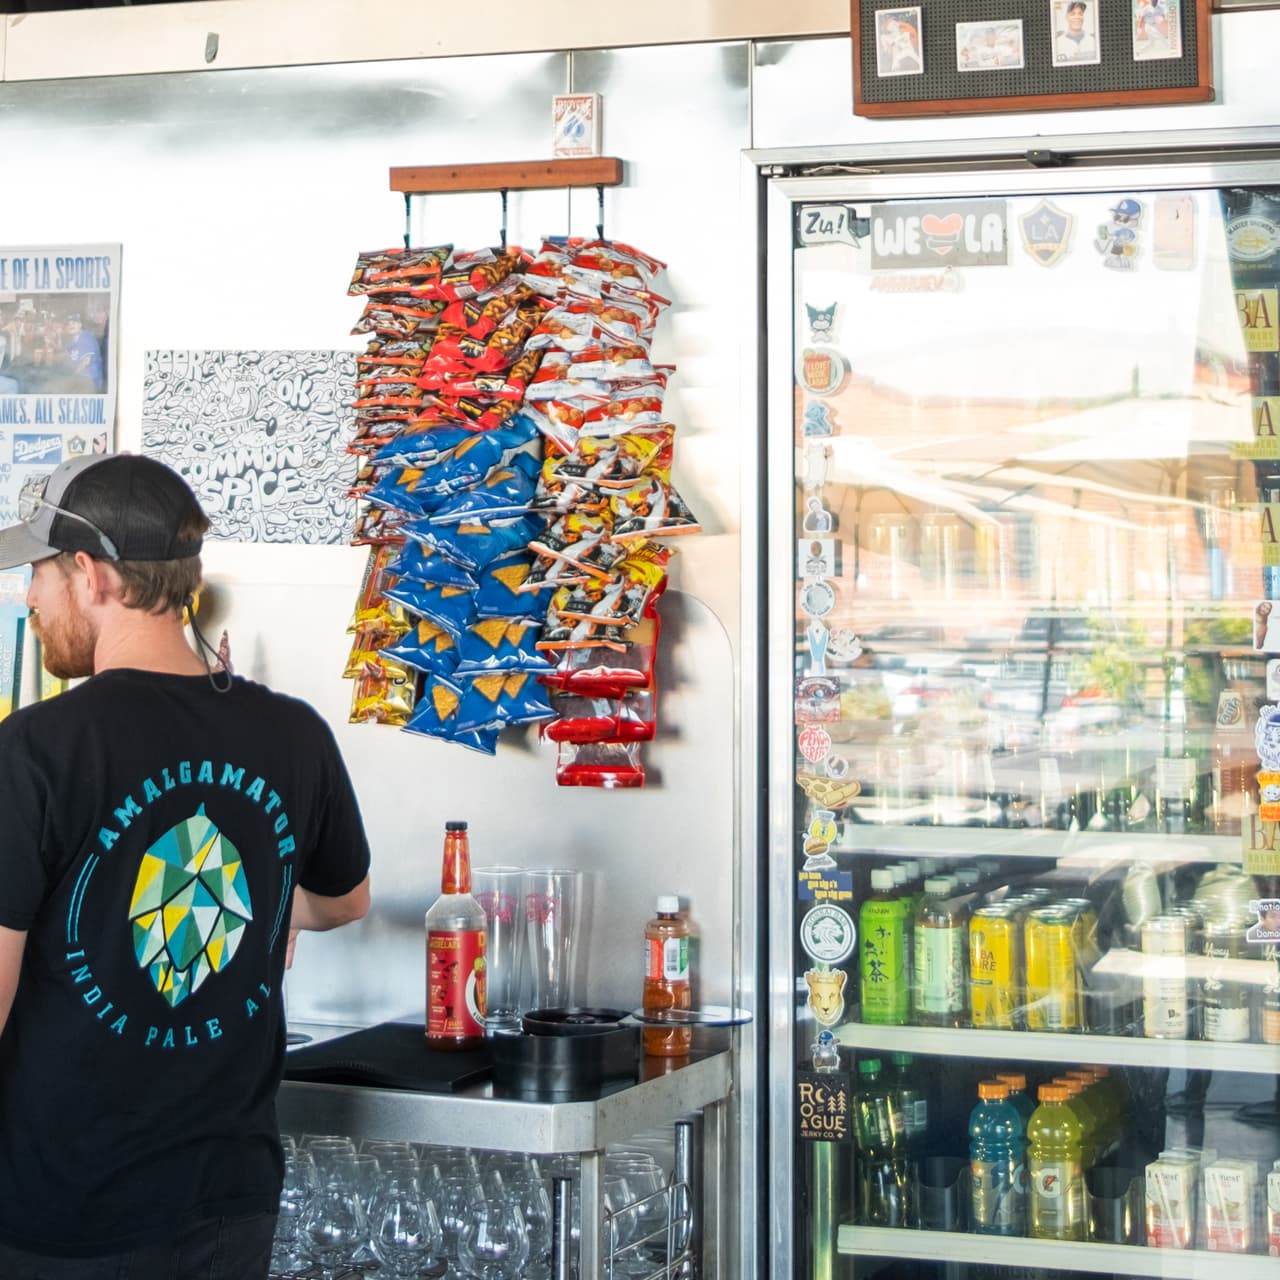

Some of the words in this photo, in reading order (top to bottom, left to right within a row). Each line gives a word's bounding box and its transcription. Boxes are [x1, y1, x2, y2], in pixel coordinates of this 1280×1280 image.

[874, 217, 920, 256] WE
[965, 214, 1002, 253] LA
[12, 257, 31, 290] OF
[34, 257, 51, 289] LA
[56, 256, 111, 289] SPORTS
[277, 375, 311, 410] OK
[35, 398, 55, 424] ALL
[58, 398, 106, 425] SEASON.
[16, 436, 61, 461] Dodgers
[177, 445, 303, 481] COMMON
[200, 469, 303, 513] SPACE
[98, 760, 296, 858] AMALGAMATOR
[66, 948, 128, 1034] INDIA
[246, 982, 271, 1017] AL
[145, 1017, 223, 1047] PALE
